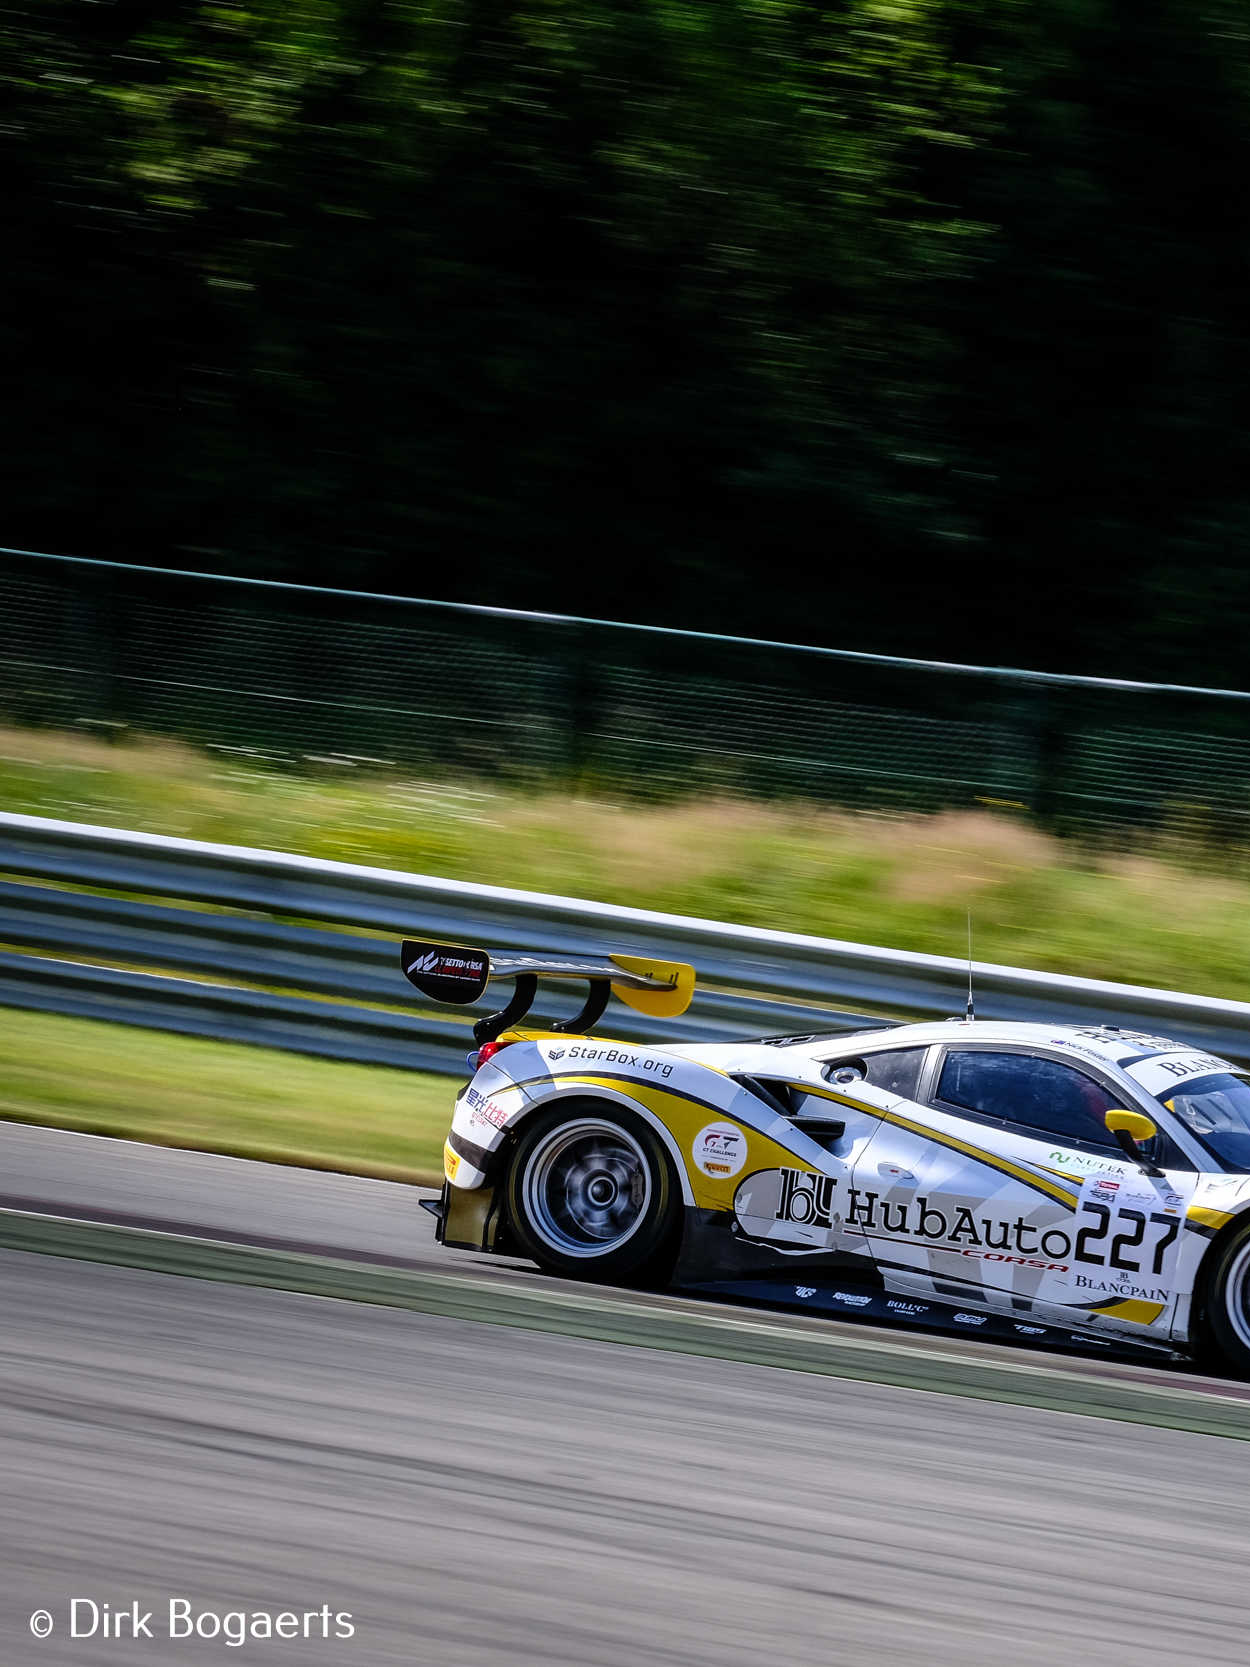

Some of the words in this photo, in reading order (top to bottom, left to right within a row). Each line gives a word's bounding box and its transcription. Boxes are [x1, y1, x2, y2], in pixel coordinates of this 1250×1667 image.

[568, 1046, 674, 1079] StarBox.org
[844, 1188, 1072, 1260] HubAuto
[1074, 1201, 1182, 1275] 227
[960, 1249, 1069, 1273] CORSA
[1075, 1275, 1170, 1301] BLANCPAIN
